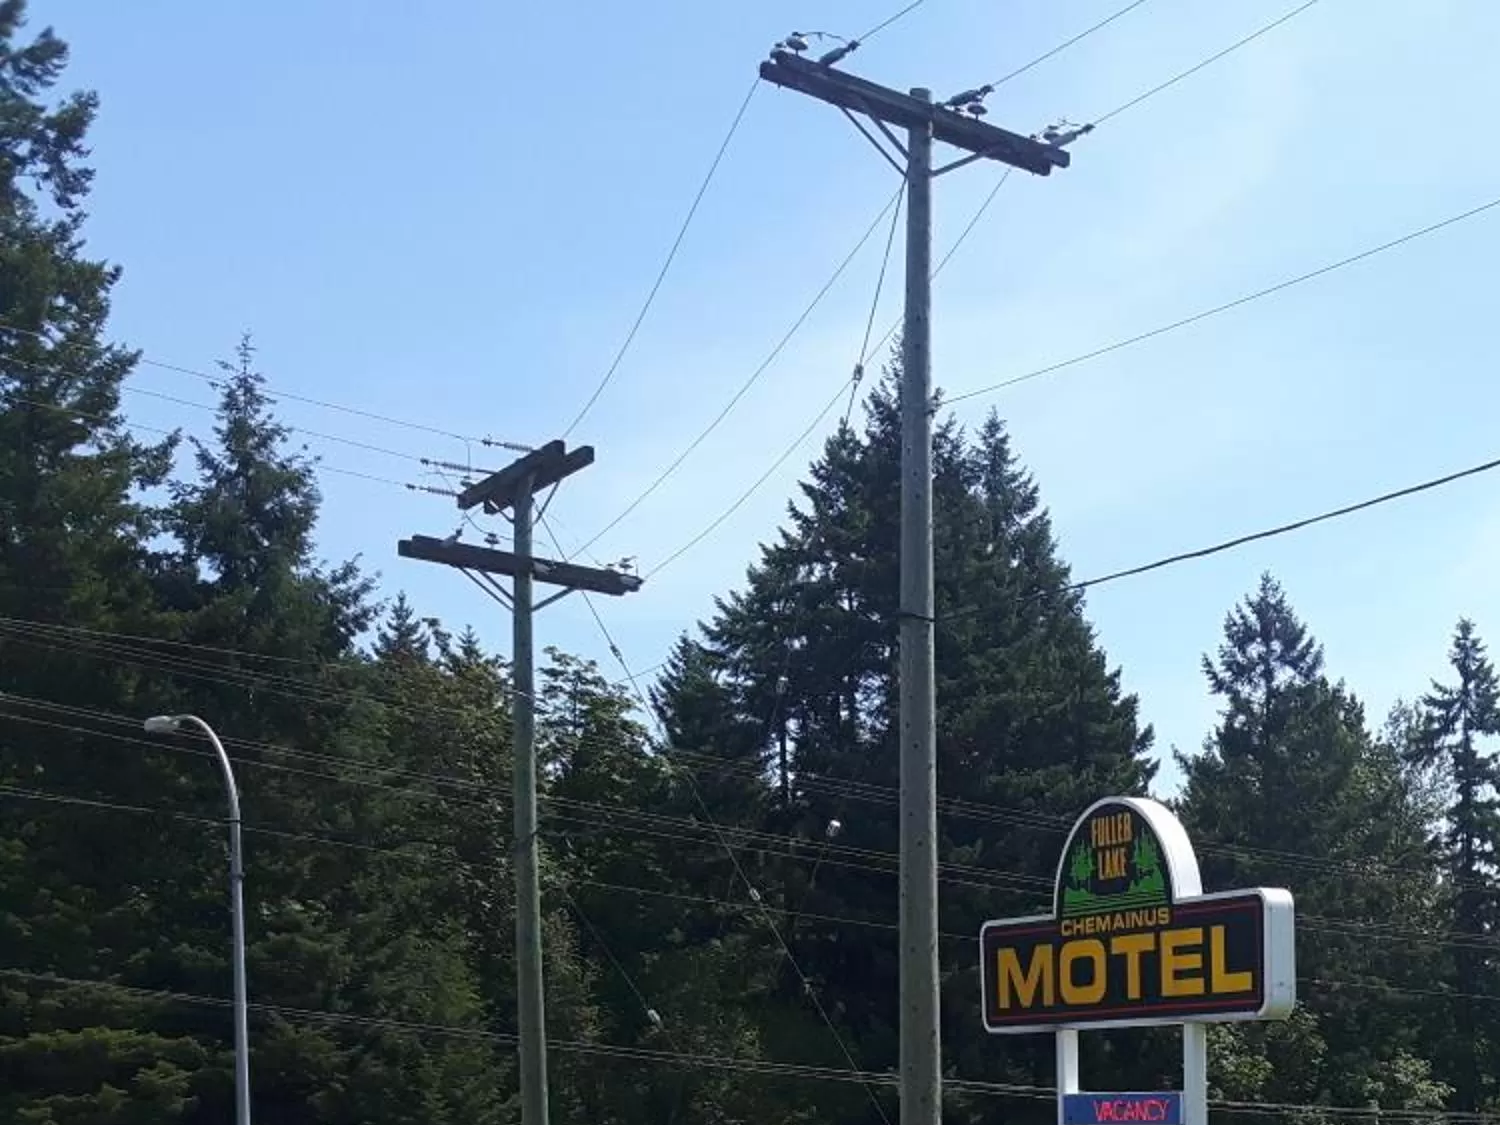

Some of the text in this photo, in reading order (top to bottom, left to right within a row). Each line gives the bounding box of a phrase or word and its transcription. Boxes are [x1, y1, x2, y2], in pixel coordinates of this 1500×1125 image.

[1091, 811, 1132, 848] FULLER
[1097, 847, 1127, 880] LAKE
[1061, 908, 1169, 936] CHEMAINUS
[998, 925, 1252, 1008] MOTEL
[1095, 1100, 1168, 1121] VACANCY
